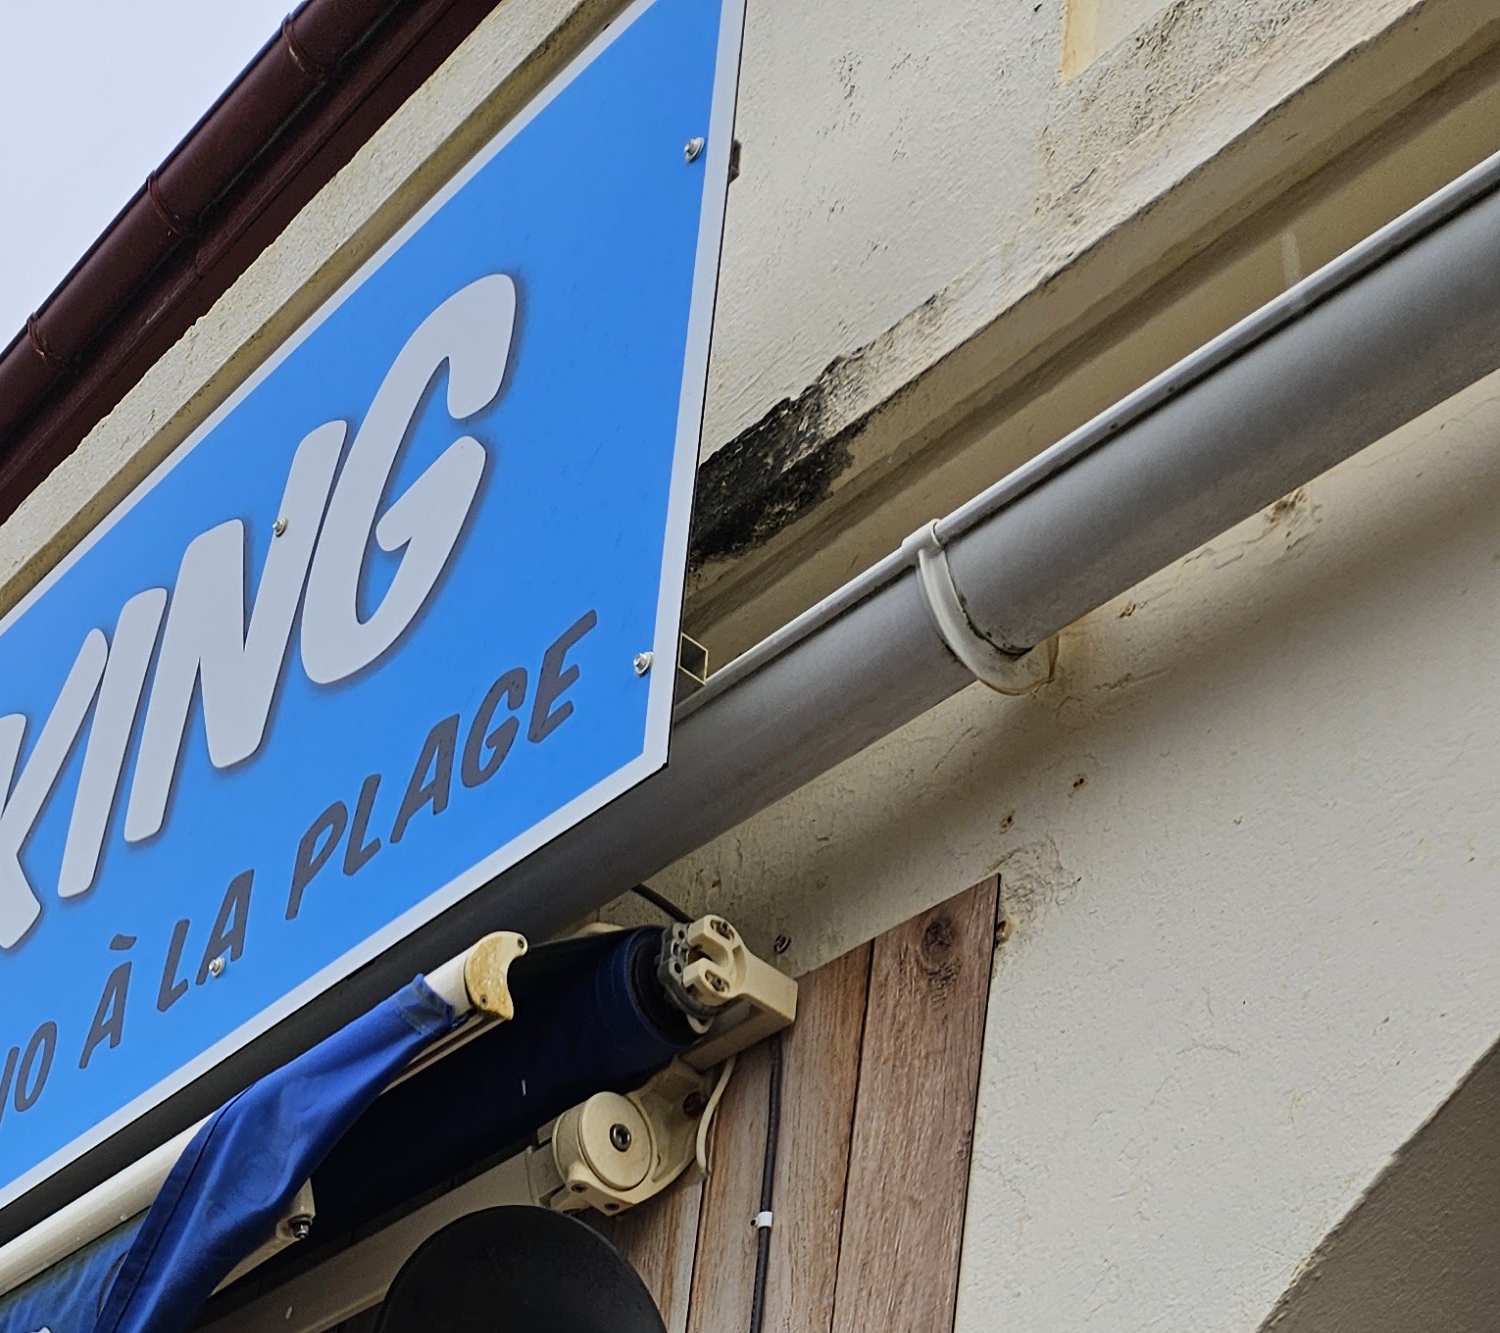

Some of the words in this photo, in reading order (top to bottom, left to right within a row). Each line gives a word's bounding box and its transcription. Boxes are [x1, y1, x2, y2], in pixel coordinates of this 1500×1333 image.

[78, 933, 138, 1070] À
[156, 868, 255, 1013] LA
[284, 609, 598, 921] PLAGE
